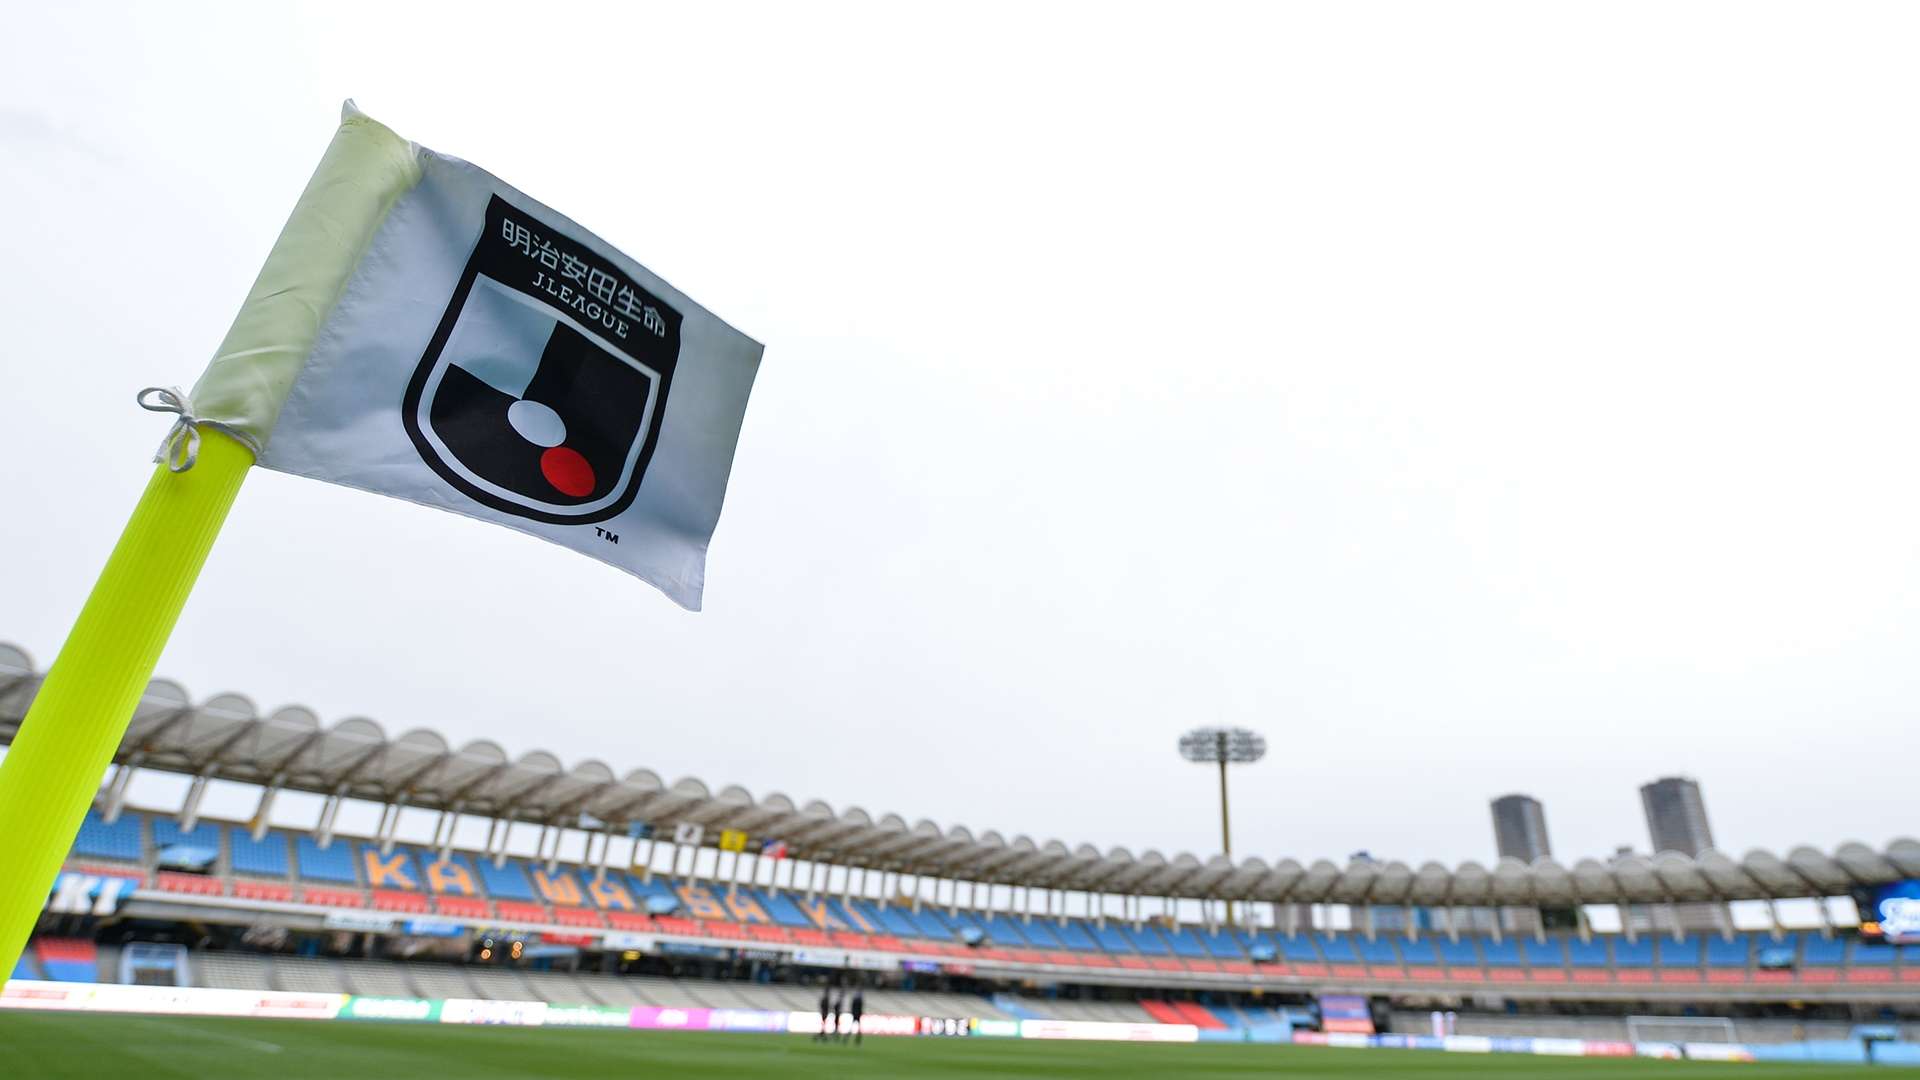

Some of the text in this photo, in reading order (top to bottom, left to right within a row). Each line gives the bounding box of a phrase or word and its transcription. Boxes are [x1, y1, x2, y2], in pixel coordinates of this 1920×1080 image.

[502, 218, 665, 337] 明治安田生命
[532, 272, 629, 339] J.LEAGUE
[595, 526, 619, 545] TM
